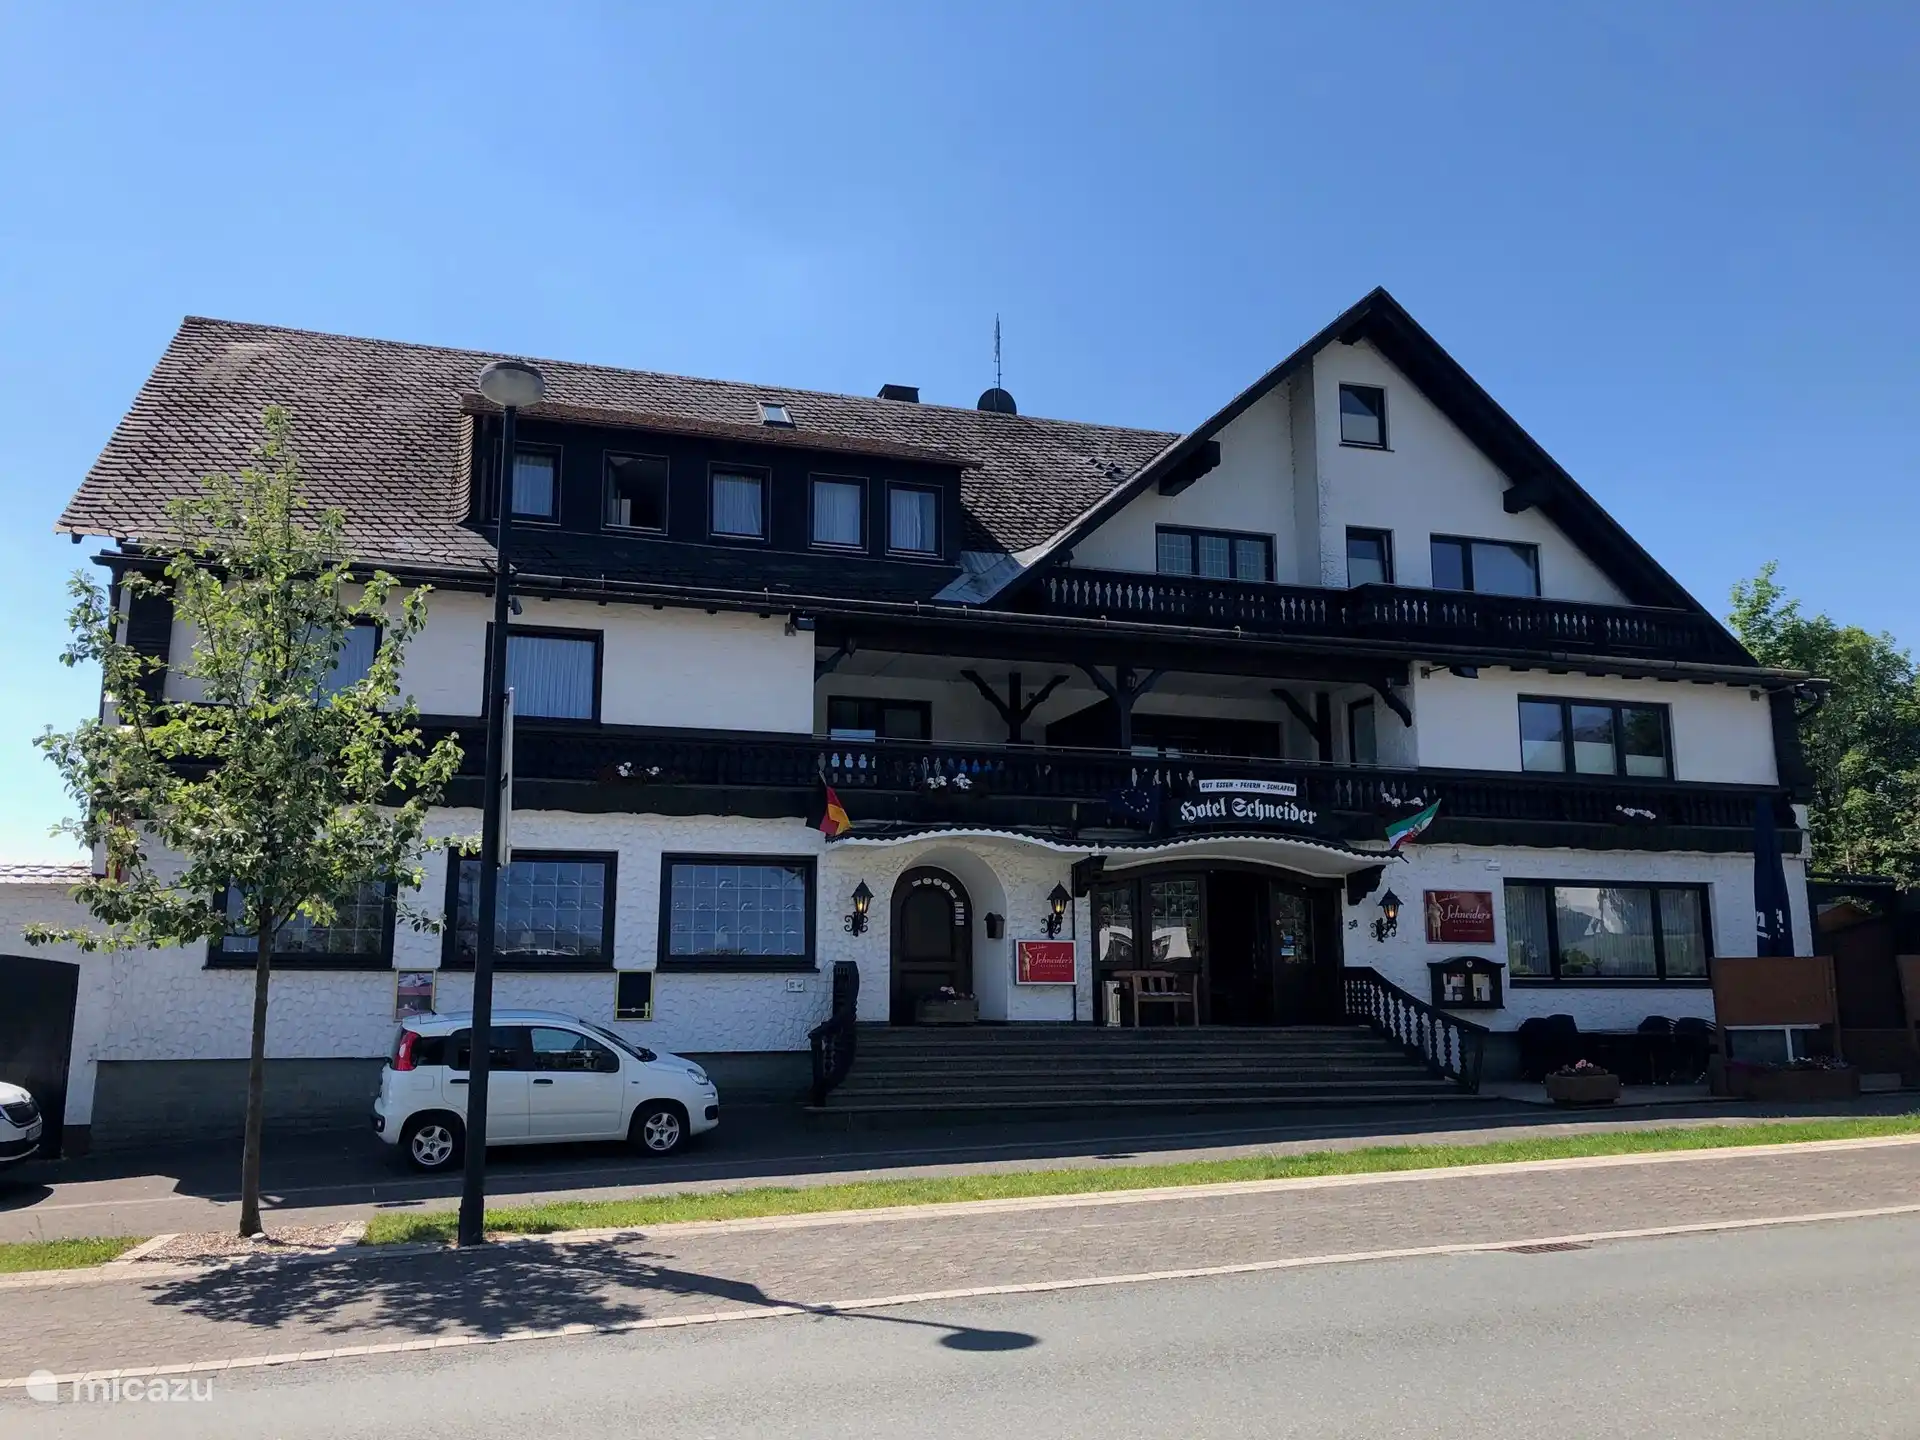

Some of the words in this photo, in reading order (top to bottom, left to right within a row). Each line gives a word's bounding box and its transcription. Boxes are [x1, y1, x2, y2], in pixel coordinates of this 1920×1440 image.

[1239, 781, 1261, 789] FEIERN
[1266, 783, 1295, 792] SCHLAFEN
[1180, 796, 1226, 823] Hotel
[1231, 797, 1317, 825] Schneider
